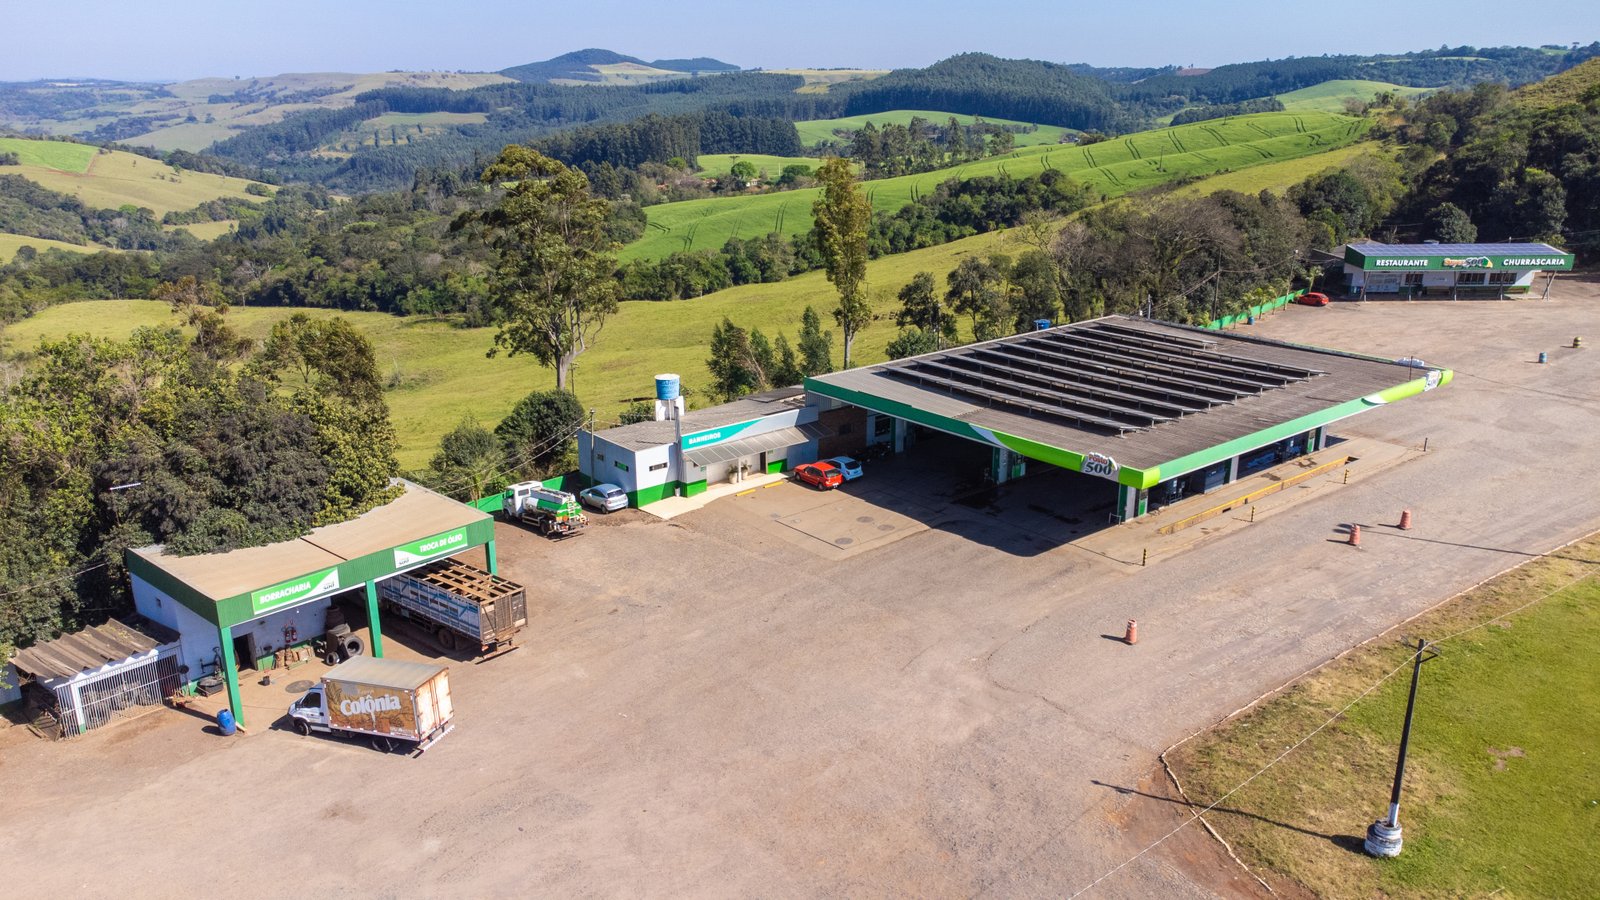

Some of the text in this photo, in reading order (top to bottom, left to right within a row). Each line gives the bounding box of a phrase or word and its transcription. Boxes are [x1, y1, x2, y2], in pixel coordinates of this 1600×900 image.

[1503, 258, 1565, 266] CHURRASCARIA
[1084, 461, 1112, 475] 500
[419, 534, 463, 552] TROCA DE ÓLEO
[259, 582, 311, 604] BORRACHARIA
[340, 694, 401, 716] Colônia
